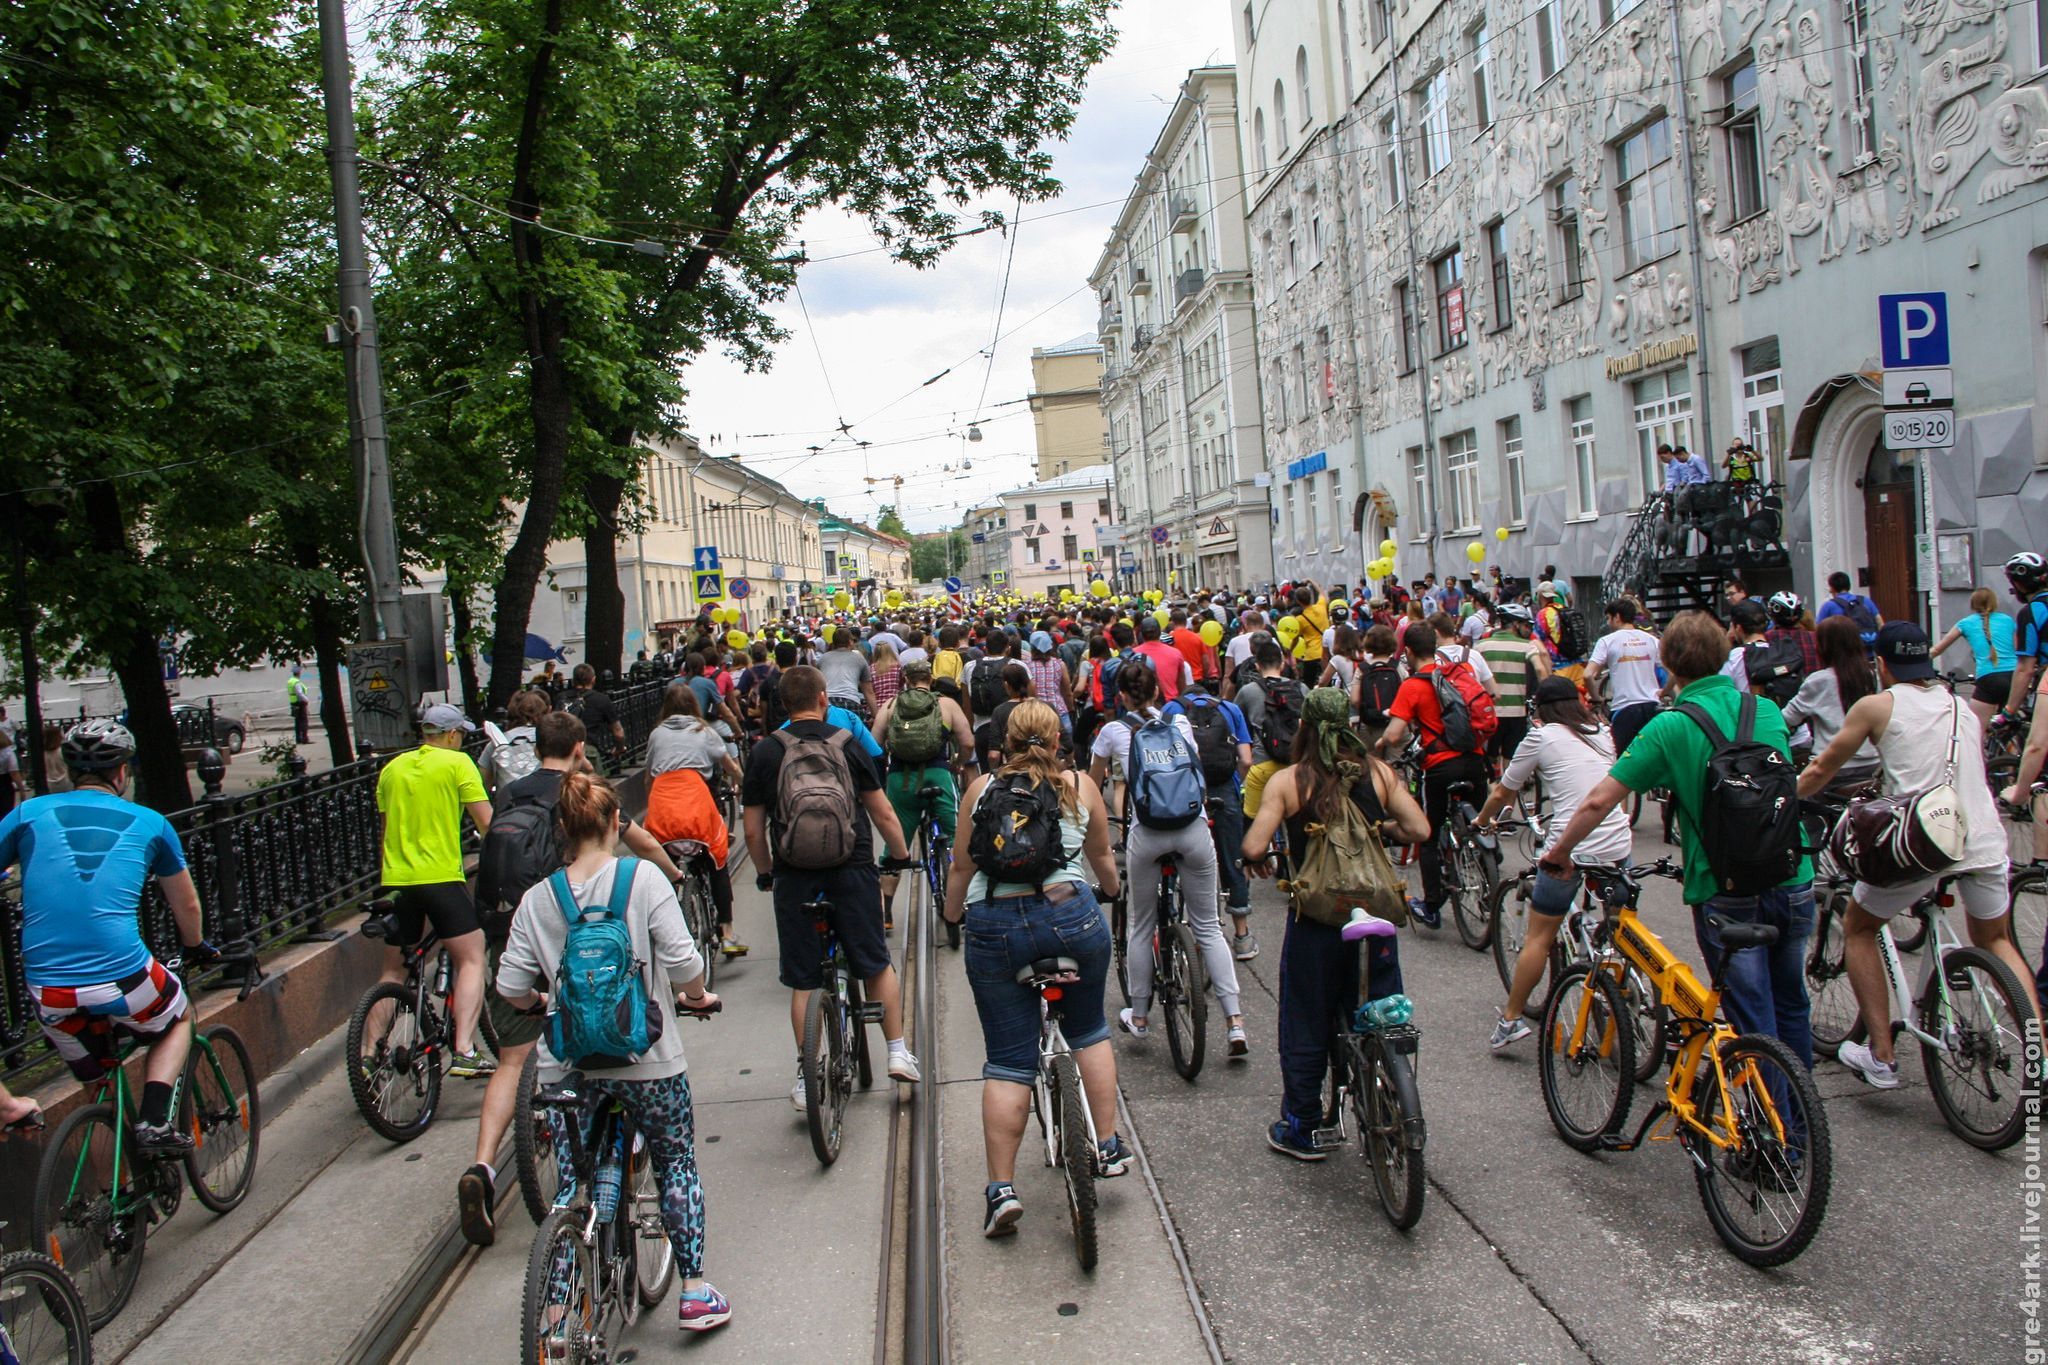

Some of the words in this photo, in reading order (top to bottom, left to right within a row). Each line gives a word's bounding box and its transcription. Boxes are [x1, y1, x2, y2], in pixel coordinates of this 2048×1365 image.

[1898, 301, 1936, 360] P
[1893, 425, 1904, 436] 10
[1908, 423, 1921, 436] 15
[1926, 421, 1946, 437] 20
[1144, 740, 1188, 765] NIKE
[1928, 807, 1951, 820] FRED
